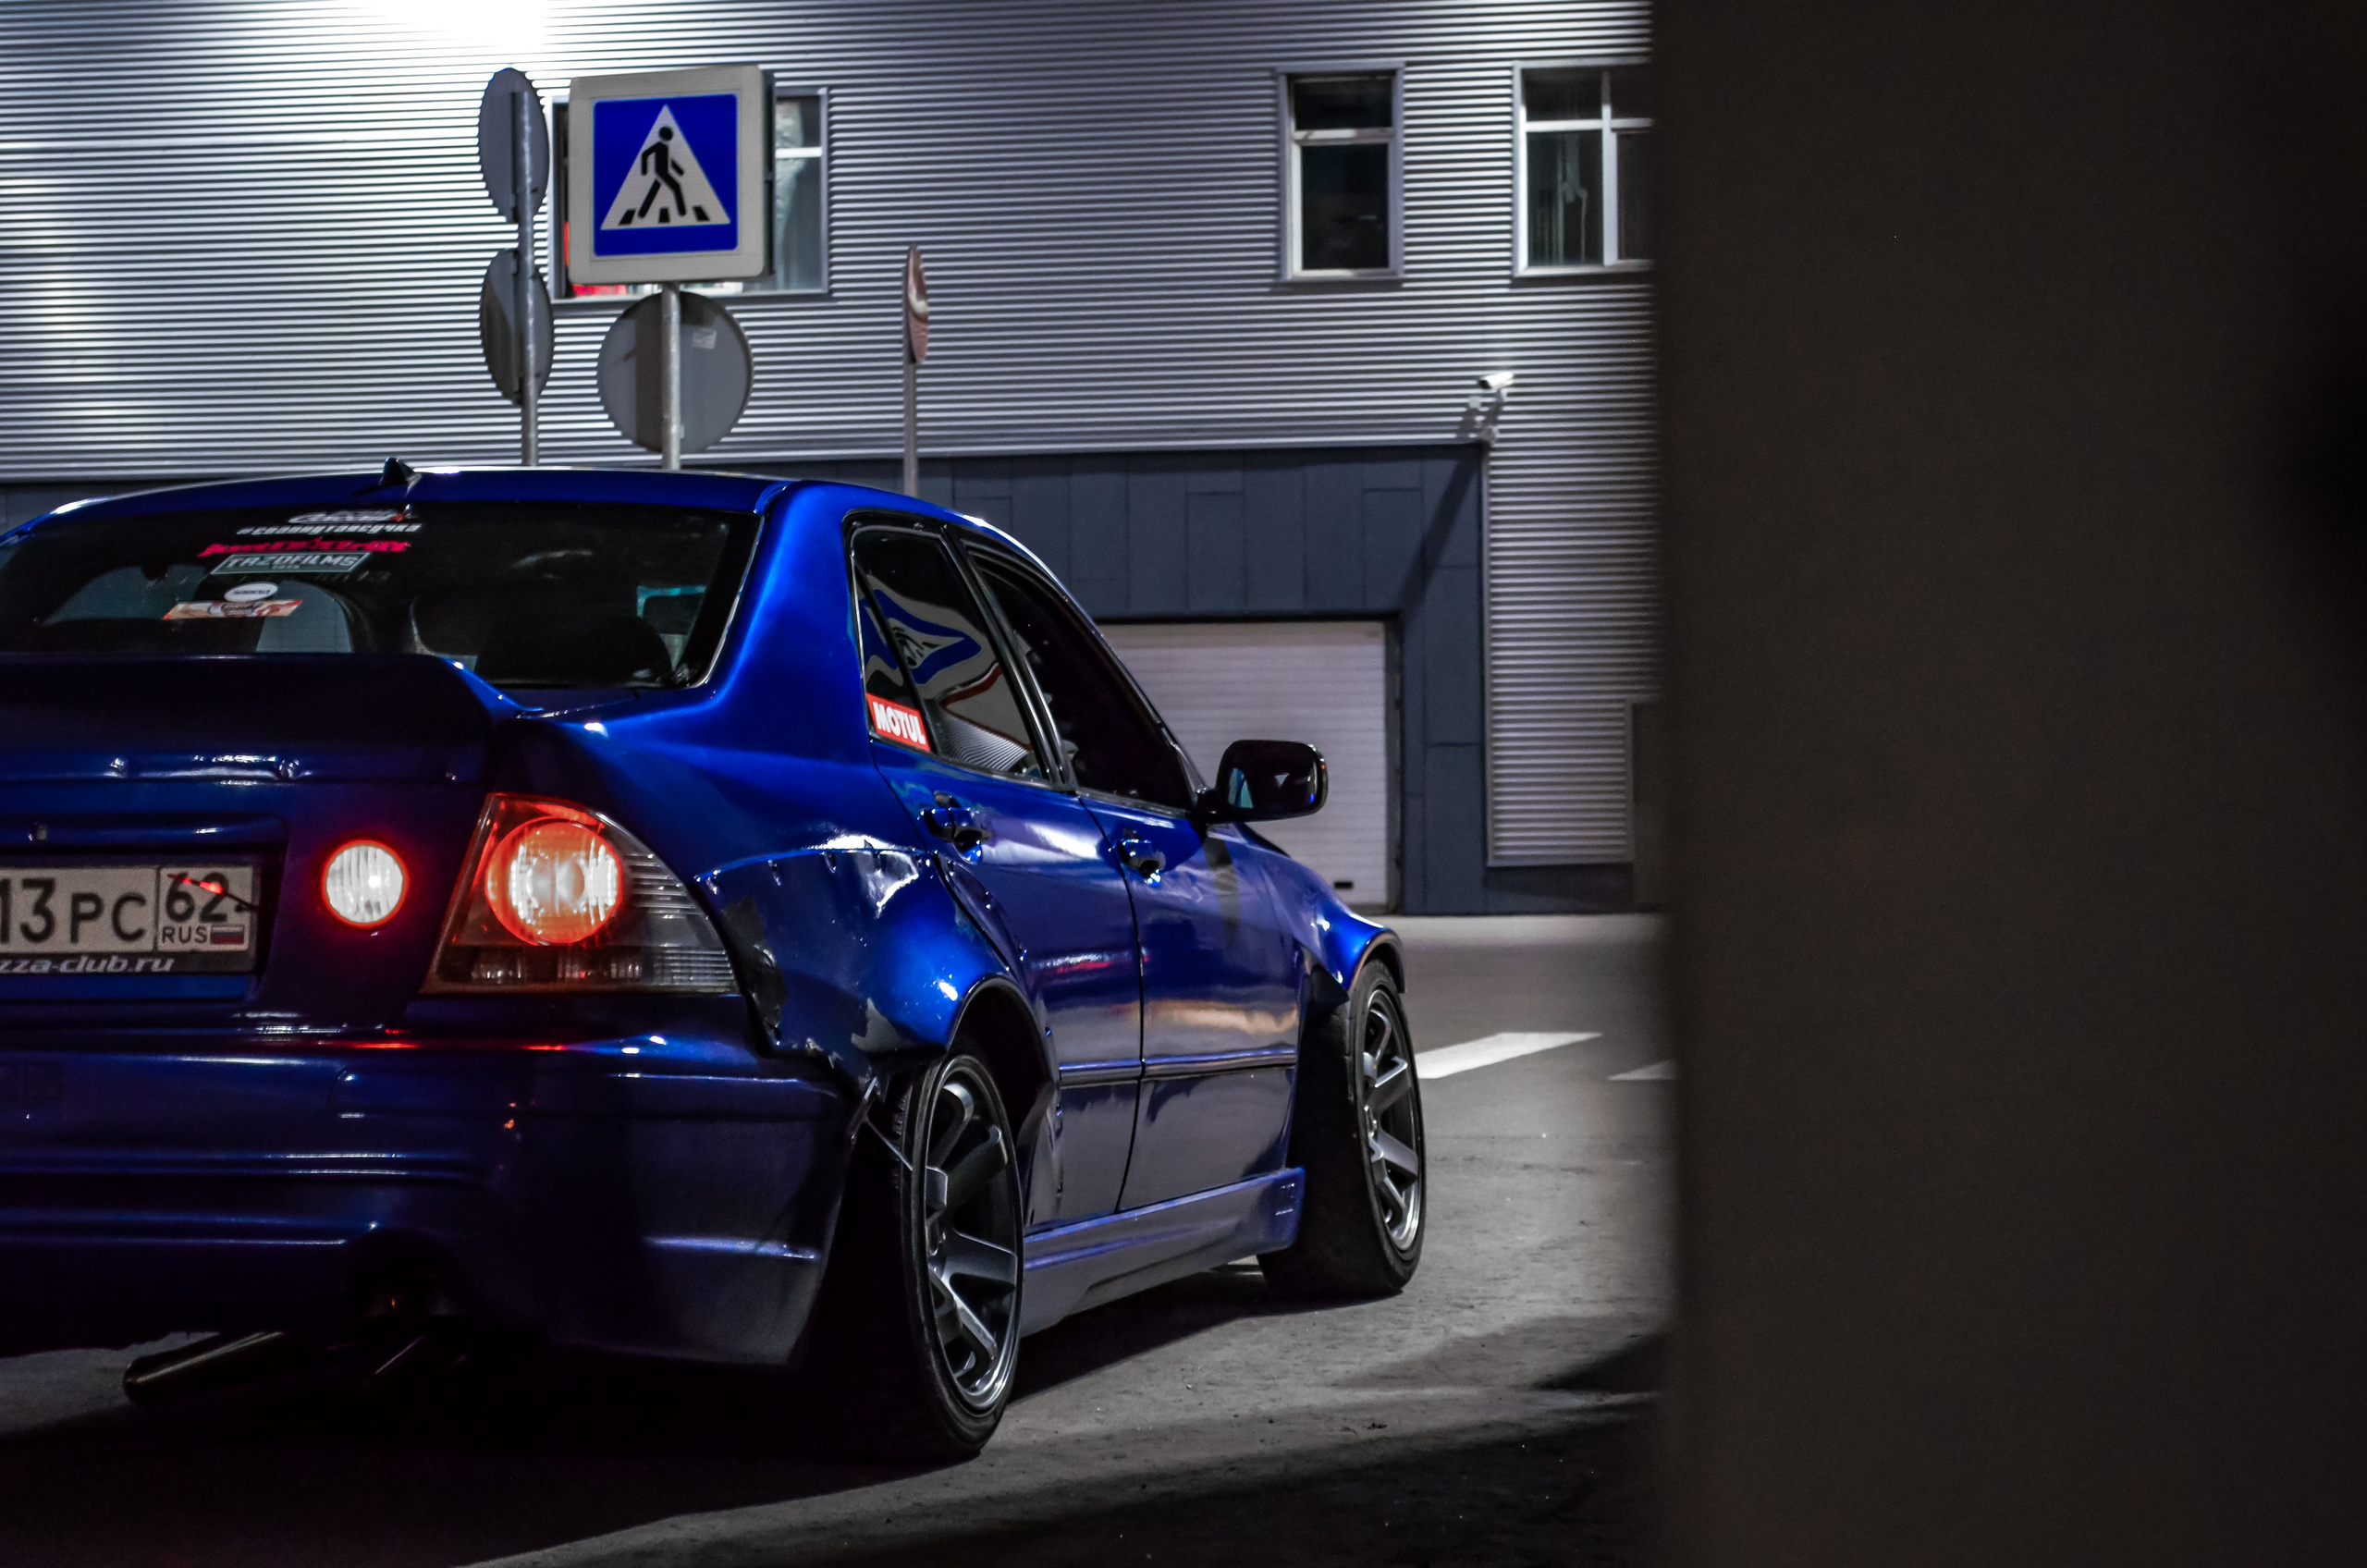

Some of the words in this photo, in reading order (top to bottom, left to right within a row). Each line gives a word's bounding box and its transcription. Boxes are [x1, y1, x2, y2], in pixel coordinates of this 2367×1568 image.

[873, 701, 926, 745] MOTUL
[165, 872, 228, 923] 62
[162, 926, 206, 944] RUS
